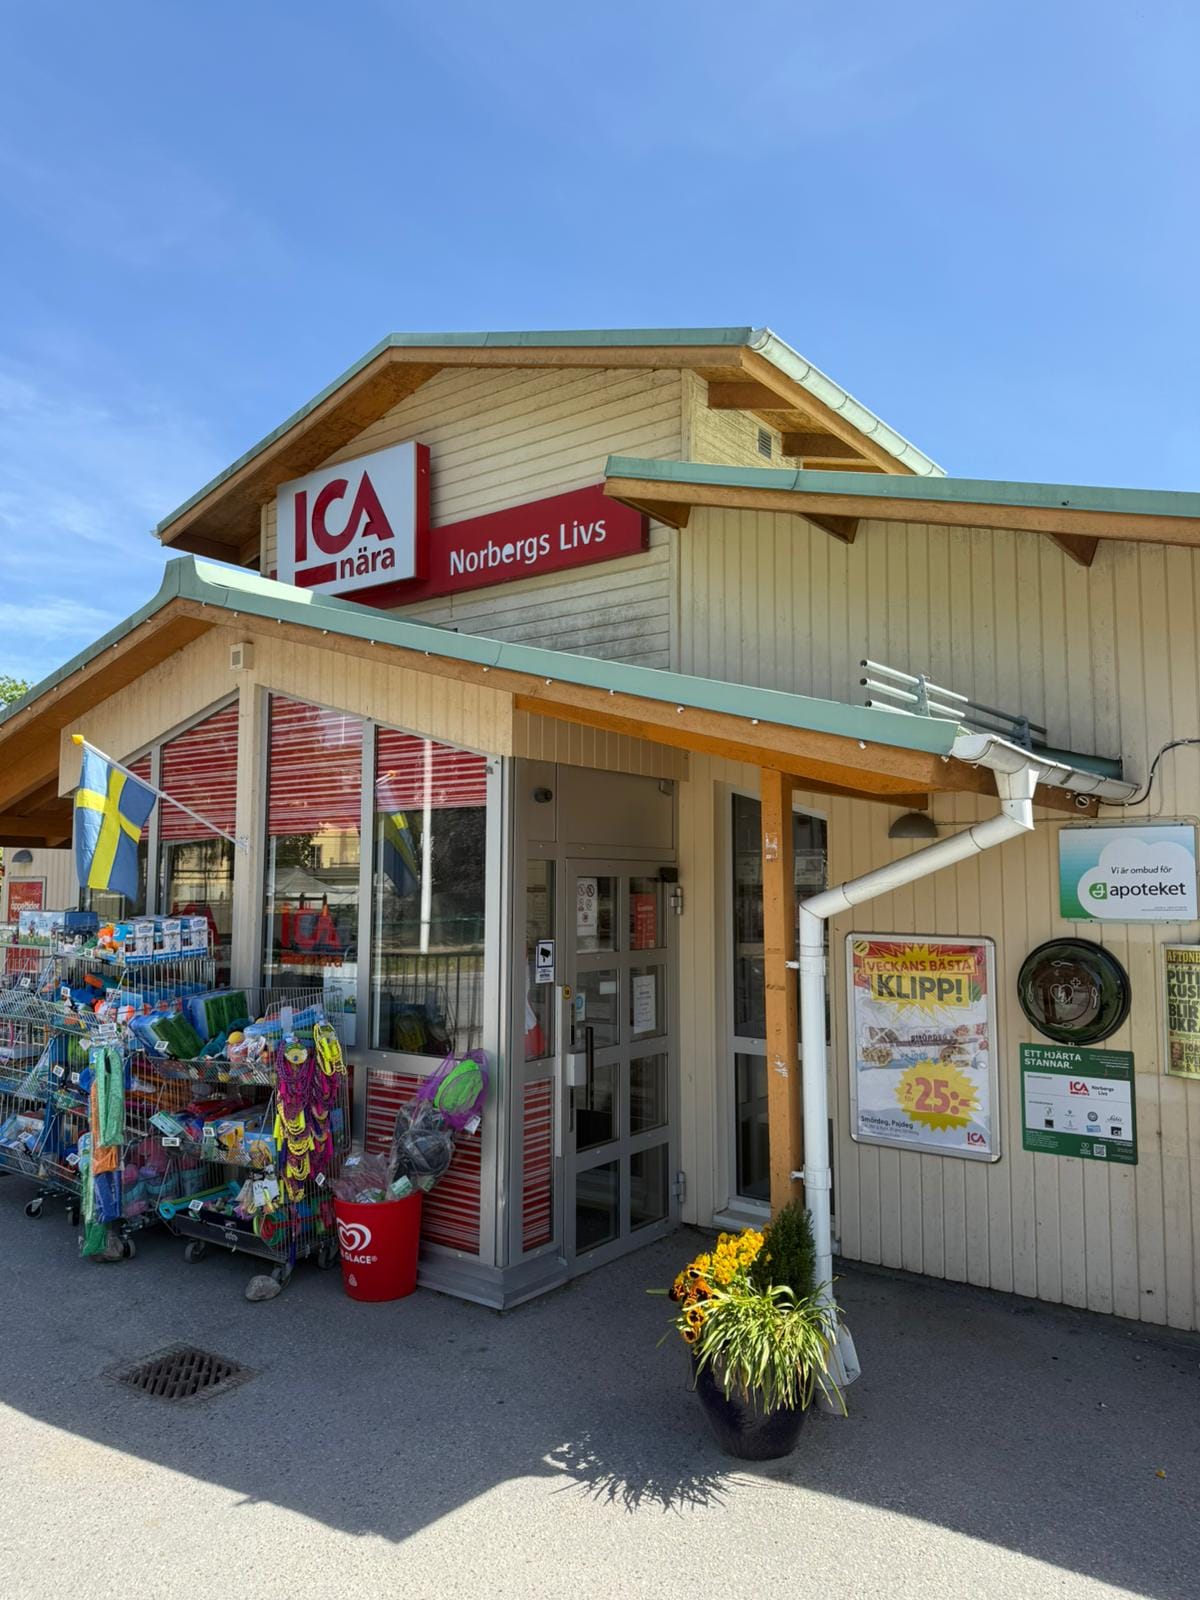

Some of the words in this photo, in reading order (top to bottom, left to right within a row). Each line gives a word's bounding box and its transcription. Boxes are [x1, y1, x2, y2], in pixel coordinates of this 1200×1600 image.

[294, 470, 395, 563] ICA
[449, 531, 550, 577] Norbergs
[559, 518, 607, 551] Livs
[339, 545, 395, 580] nära
[1111, 866, 1120, 874] Vi
[1120, 866, 1129, 874] är
[1130, 866, 1159, 874] ombud
[1160, 865, 1172, 874] för
[1109, 882, 1187, 899] apoteket
[866, 959, 926, 972] VECKANS
[929, 958, 971, 972] BÄSTA
[877, 974, 963, 1002] KLIPP!
[1168, 1003, 1199, 1019] BLIR
[1024, 1049, 1041, 1057] ETT
[1044, 1050, 1082, 1061] HJÄRTA
[1024, 1058, 1073, 1069] STANNAR.
[906, 1083, 913, 1095] 2
[1069, 1081, 1089, 1093] ICA
[967, 1132, 986, 1144] ICA
